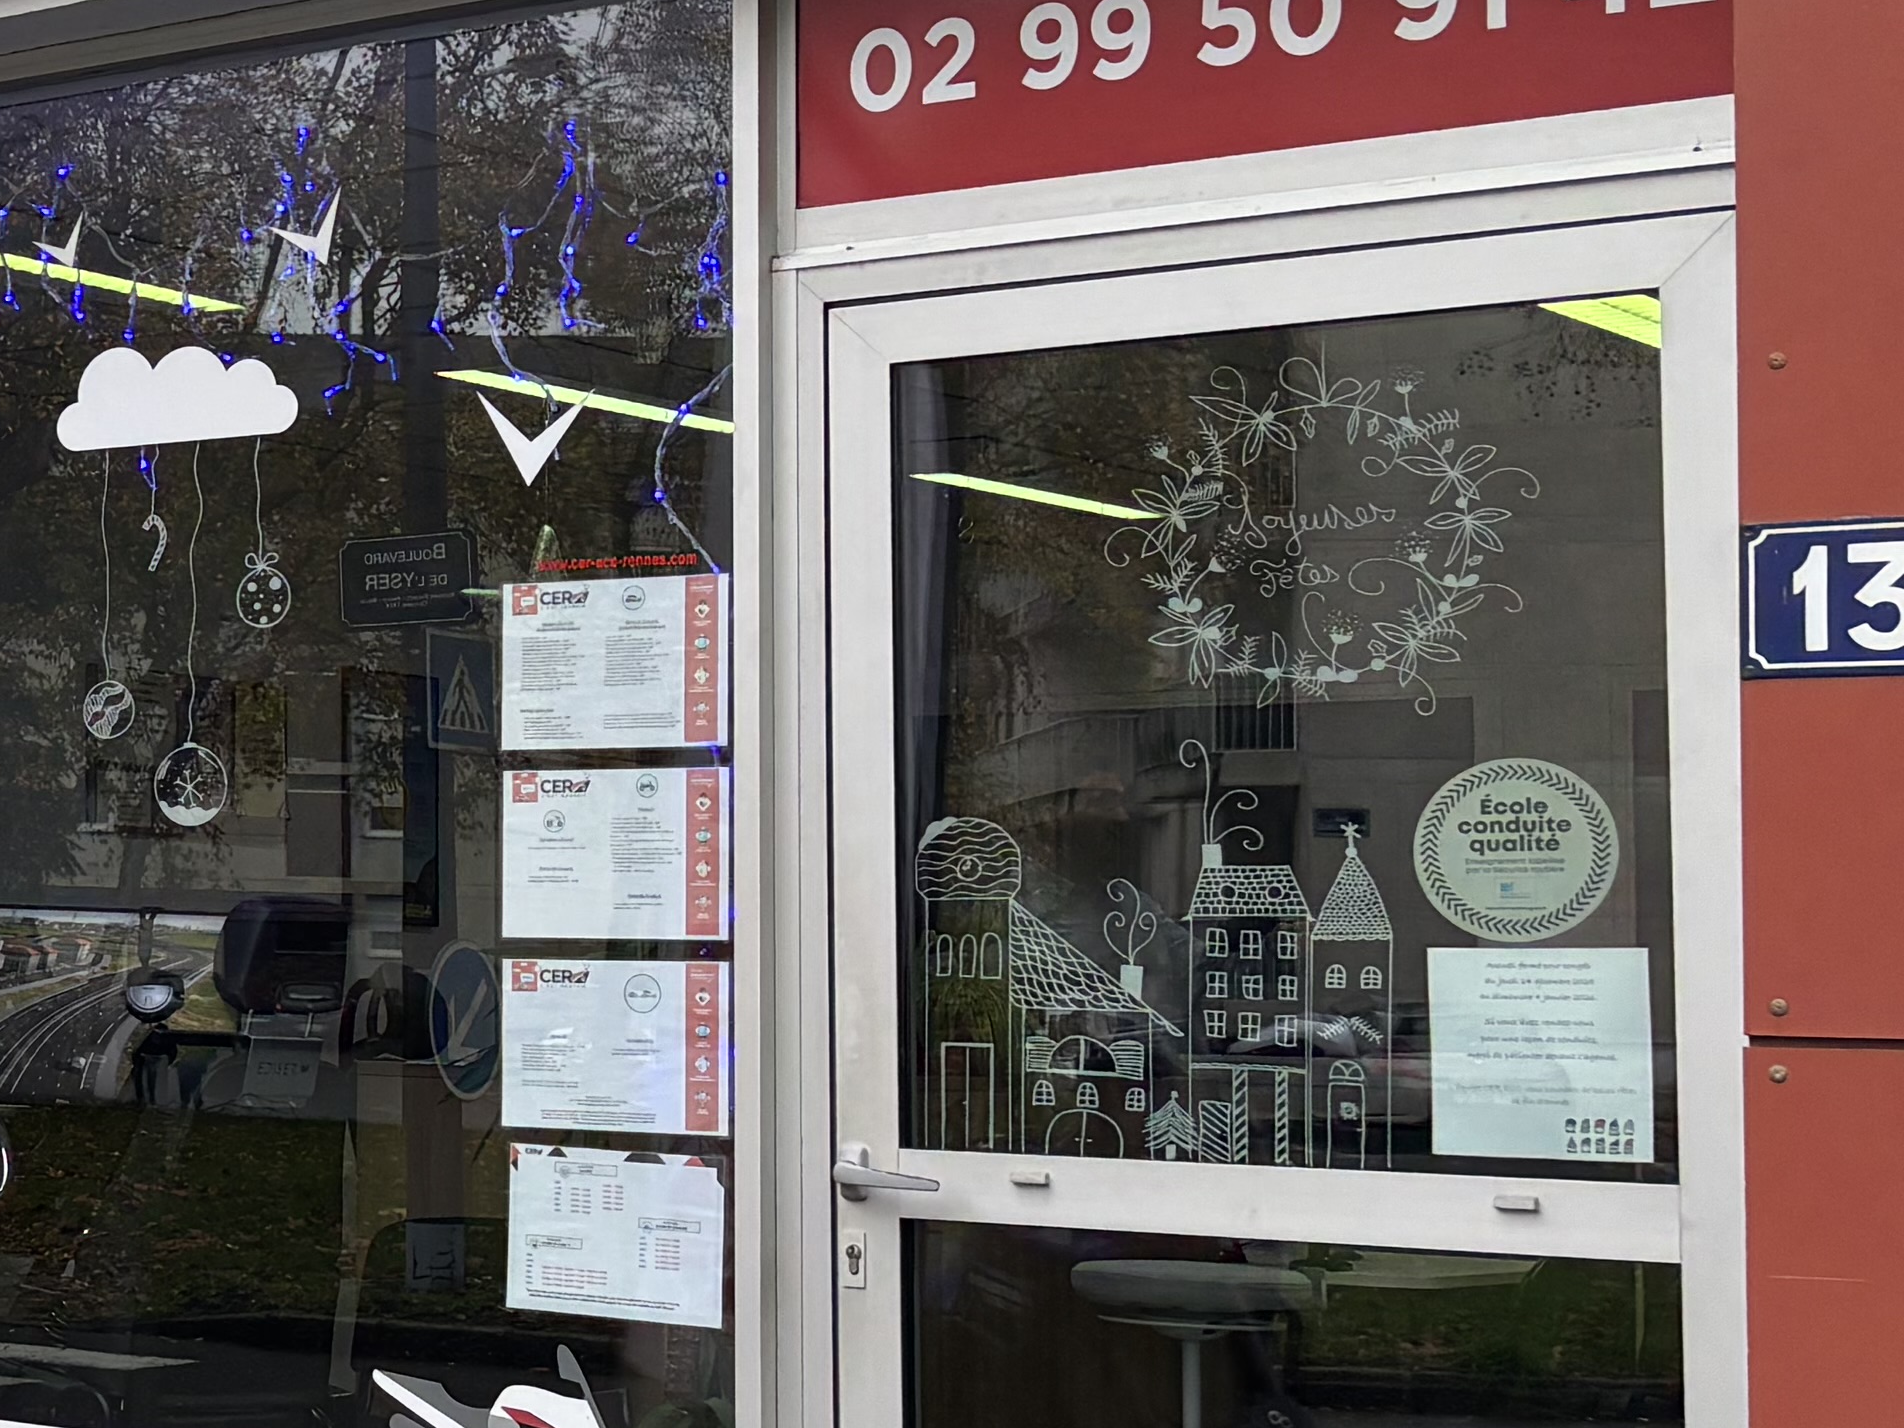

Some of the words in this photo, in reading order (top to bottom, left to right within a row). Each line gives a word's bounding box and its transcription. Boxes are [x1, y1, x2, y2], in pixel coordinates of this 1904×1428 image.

[849, 15, 977, 114] 02
[540, 590, 573, 606] CER
[1793, 541, 1904, 652] 13
[540, 779, 573, 794] CER
[1480, 794, 1548, 815] École
[1457, 816, 1572, 834] conduite
[1469, 833, 1561, 856] qualité
[539, 968, 573, 984] CER
